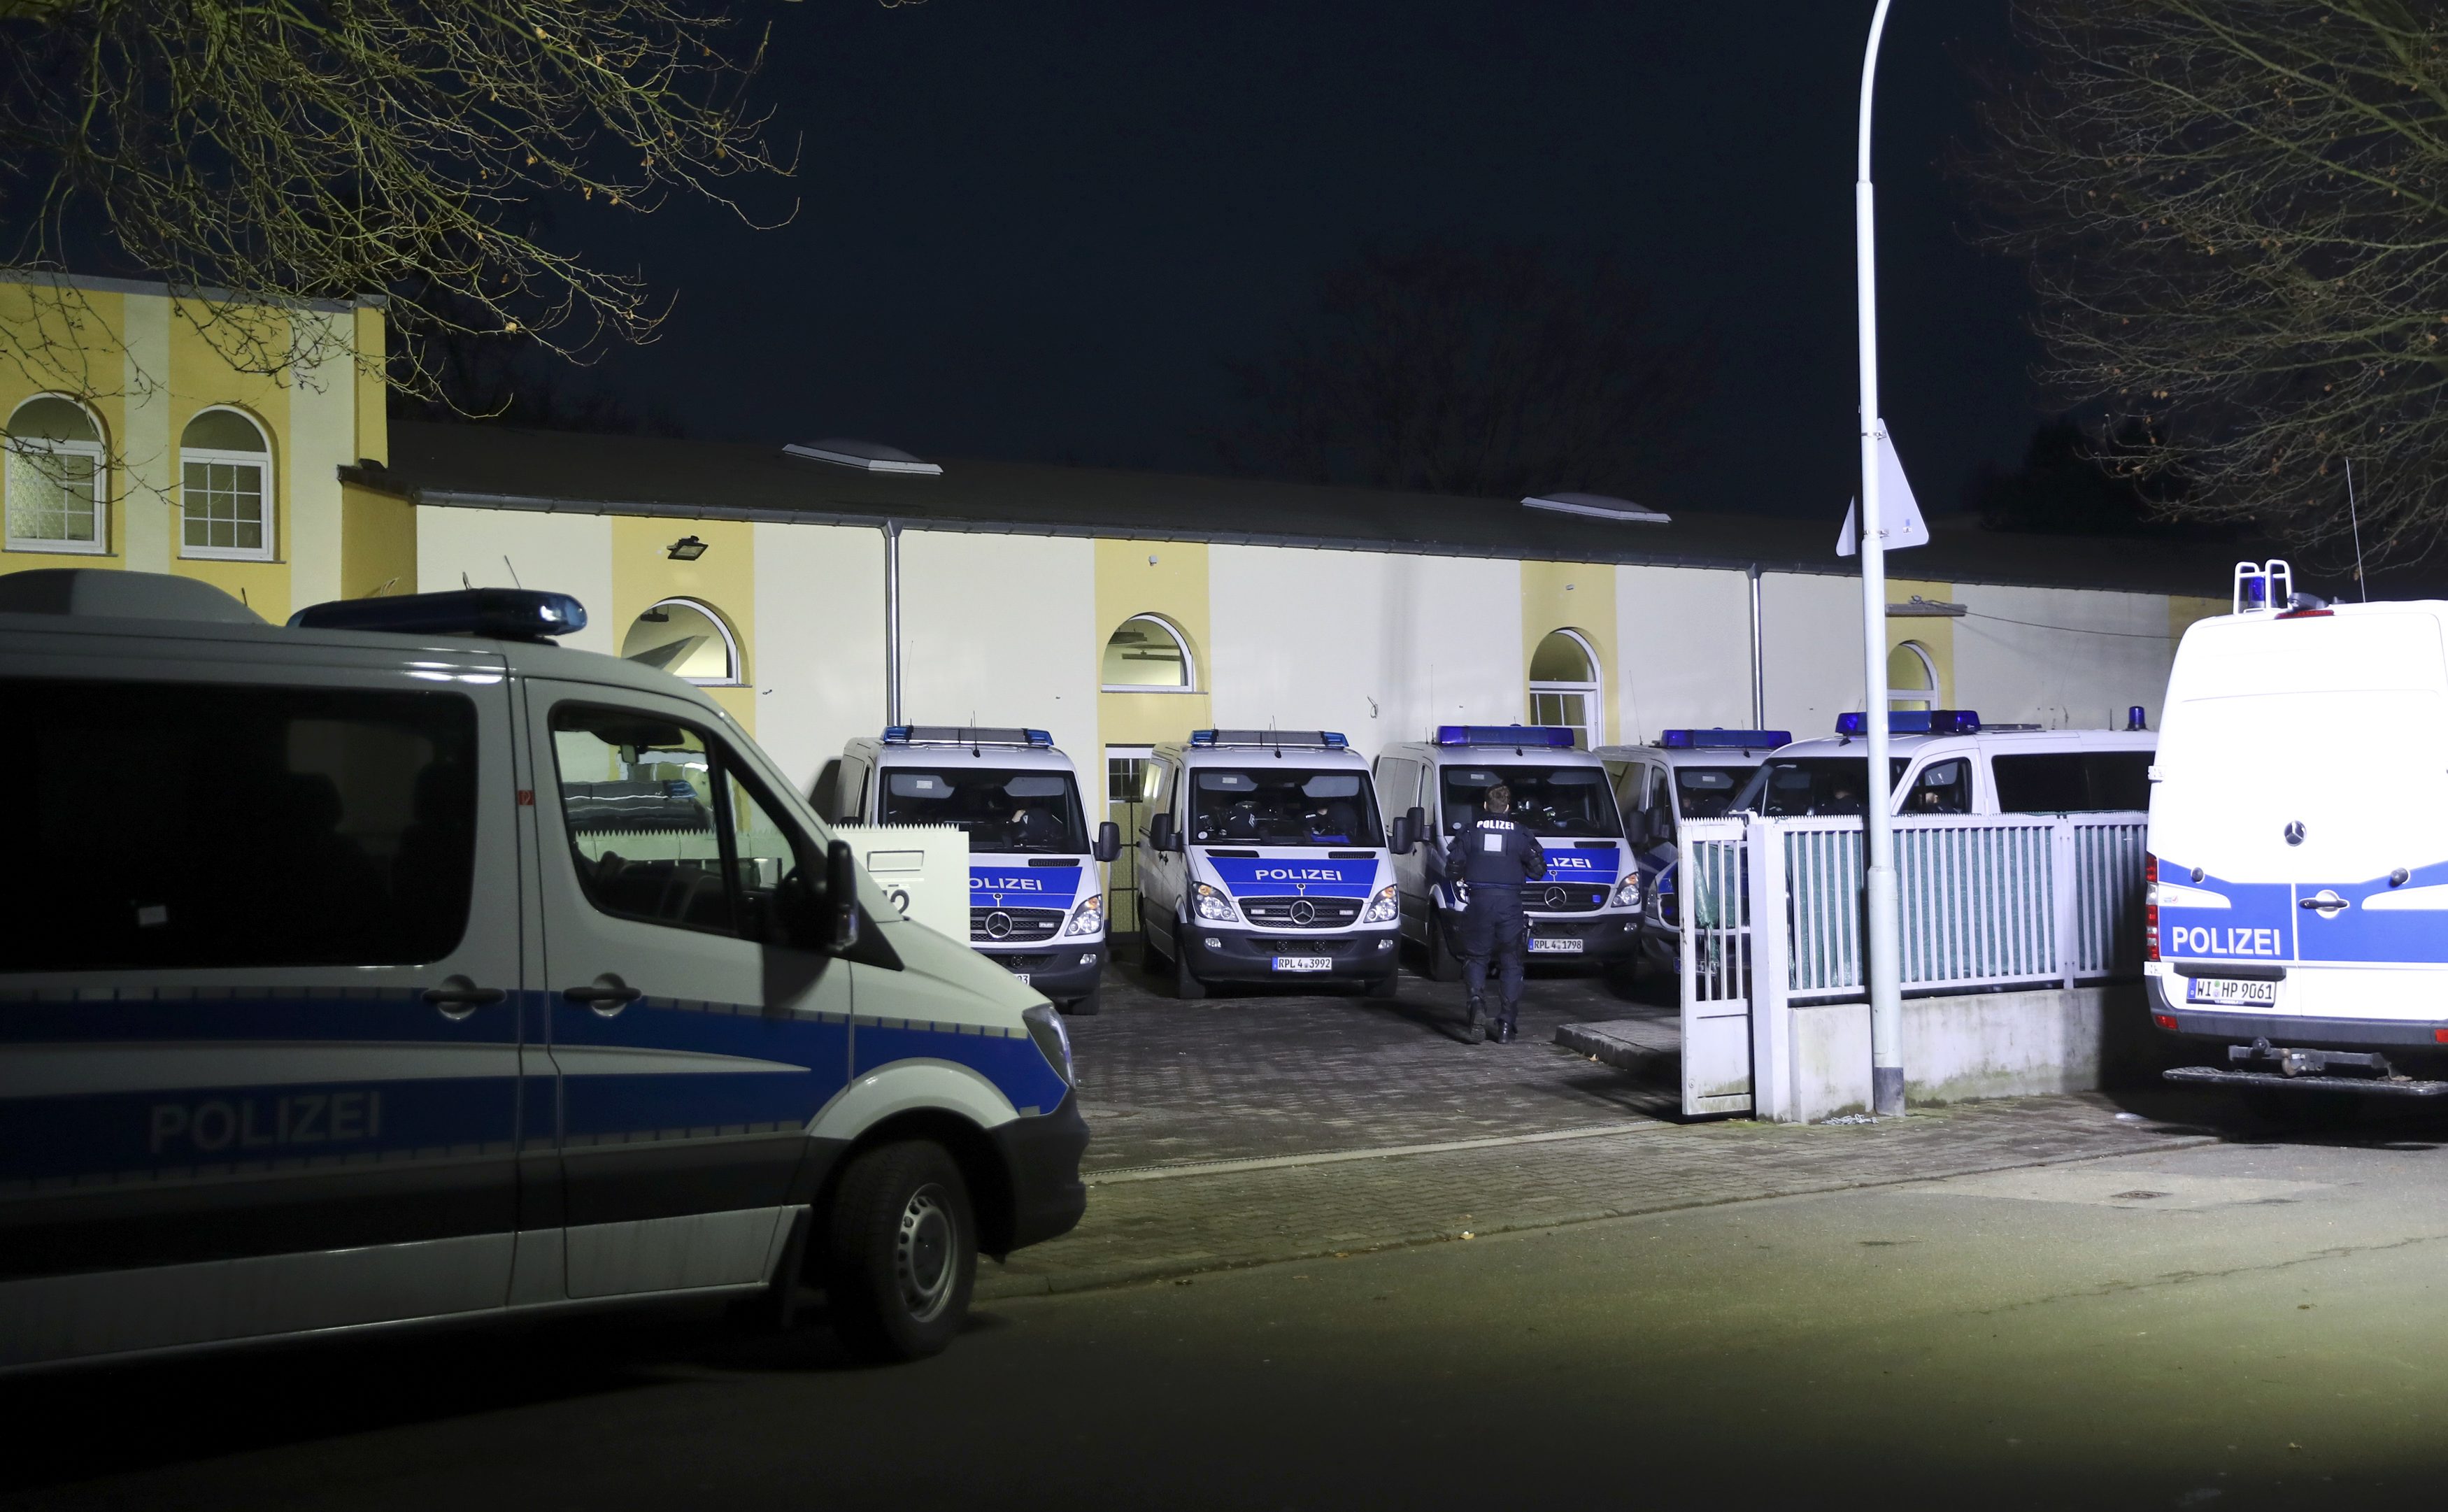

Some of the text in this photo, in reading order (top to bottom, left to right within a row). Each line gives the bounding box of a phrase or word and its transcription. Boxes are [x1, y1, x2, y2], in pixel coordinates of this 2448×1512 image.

[1476, 820, 1514, 830] POLIZEI
[1546, 857, 1592, 869] IZEI
[1255, 869, 1342, 881] POLIZEI
[969, 878, 1042, 891] OLIZEI
[1535, 940, 1581, 949] RPL 4 1798
[2172, 926, 2281, 955] POLIZEI
[1279, 959, 1331, 969] RPL 4 3992
[2197, 980, 2272, 999] WI HP 9061
[148, 1090, 381, 1154] POLIZEI
